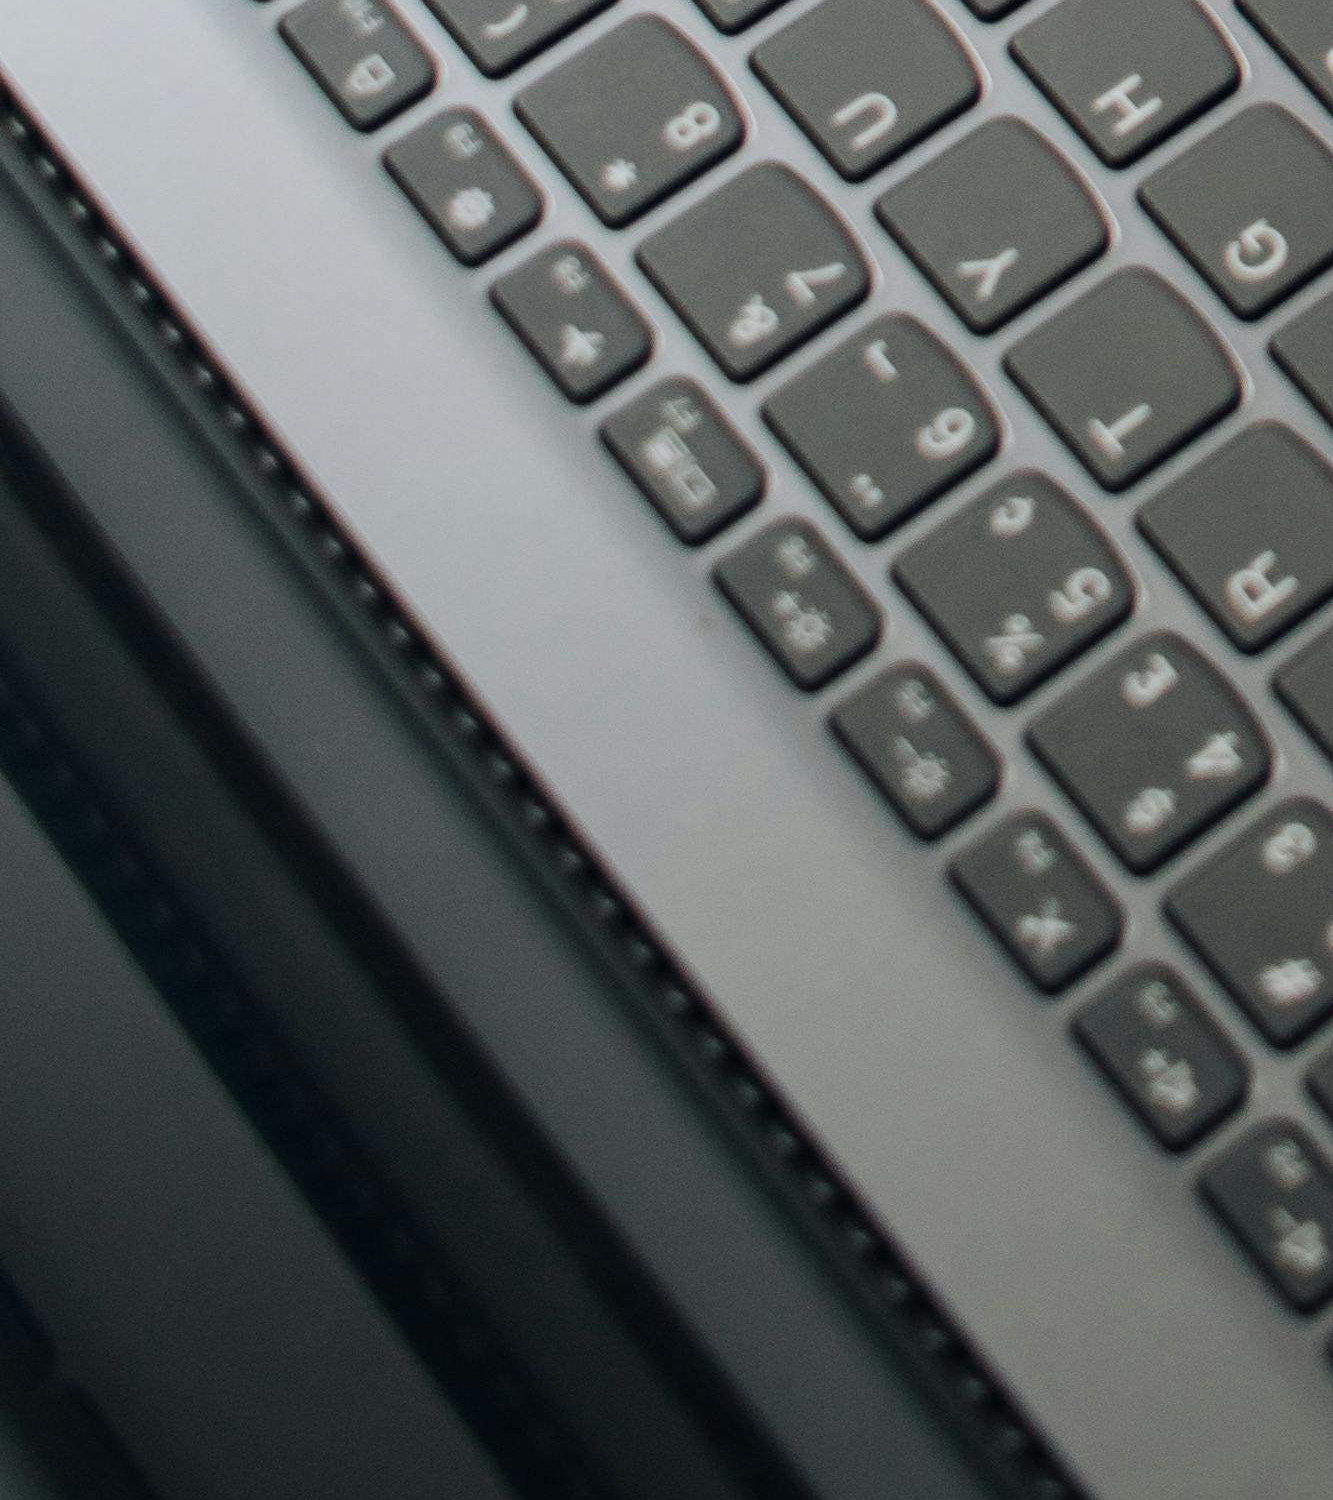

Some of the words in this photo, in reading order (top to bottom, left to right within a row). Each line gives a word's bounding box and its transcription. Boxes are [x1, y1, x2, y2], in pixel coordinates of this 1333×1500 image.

[665, 103, 718, 148] 8
[834, 94, 895, 147] U
[1094, 75, 1160, 134] H
[959, 250, 1016, 298] Y
[1227, 221, 1286, 279] G
[787, 264, 843, 304] 7
[731, 296, 776, 344] &
[918, 409, 973, 456] 6
[1090, 405, 1149, 457] T
[1051, 569, 1110, 620] 5
[1228, 552, 1296, 619] R
[987, 616, 1041, 670] %
[1188, 733, 1240, 776] 4
